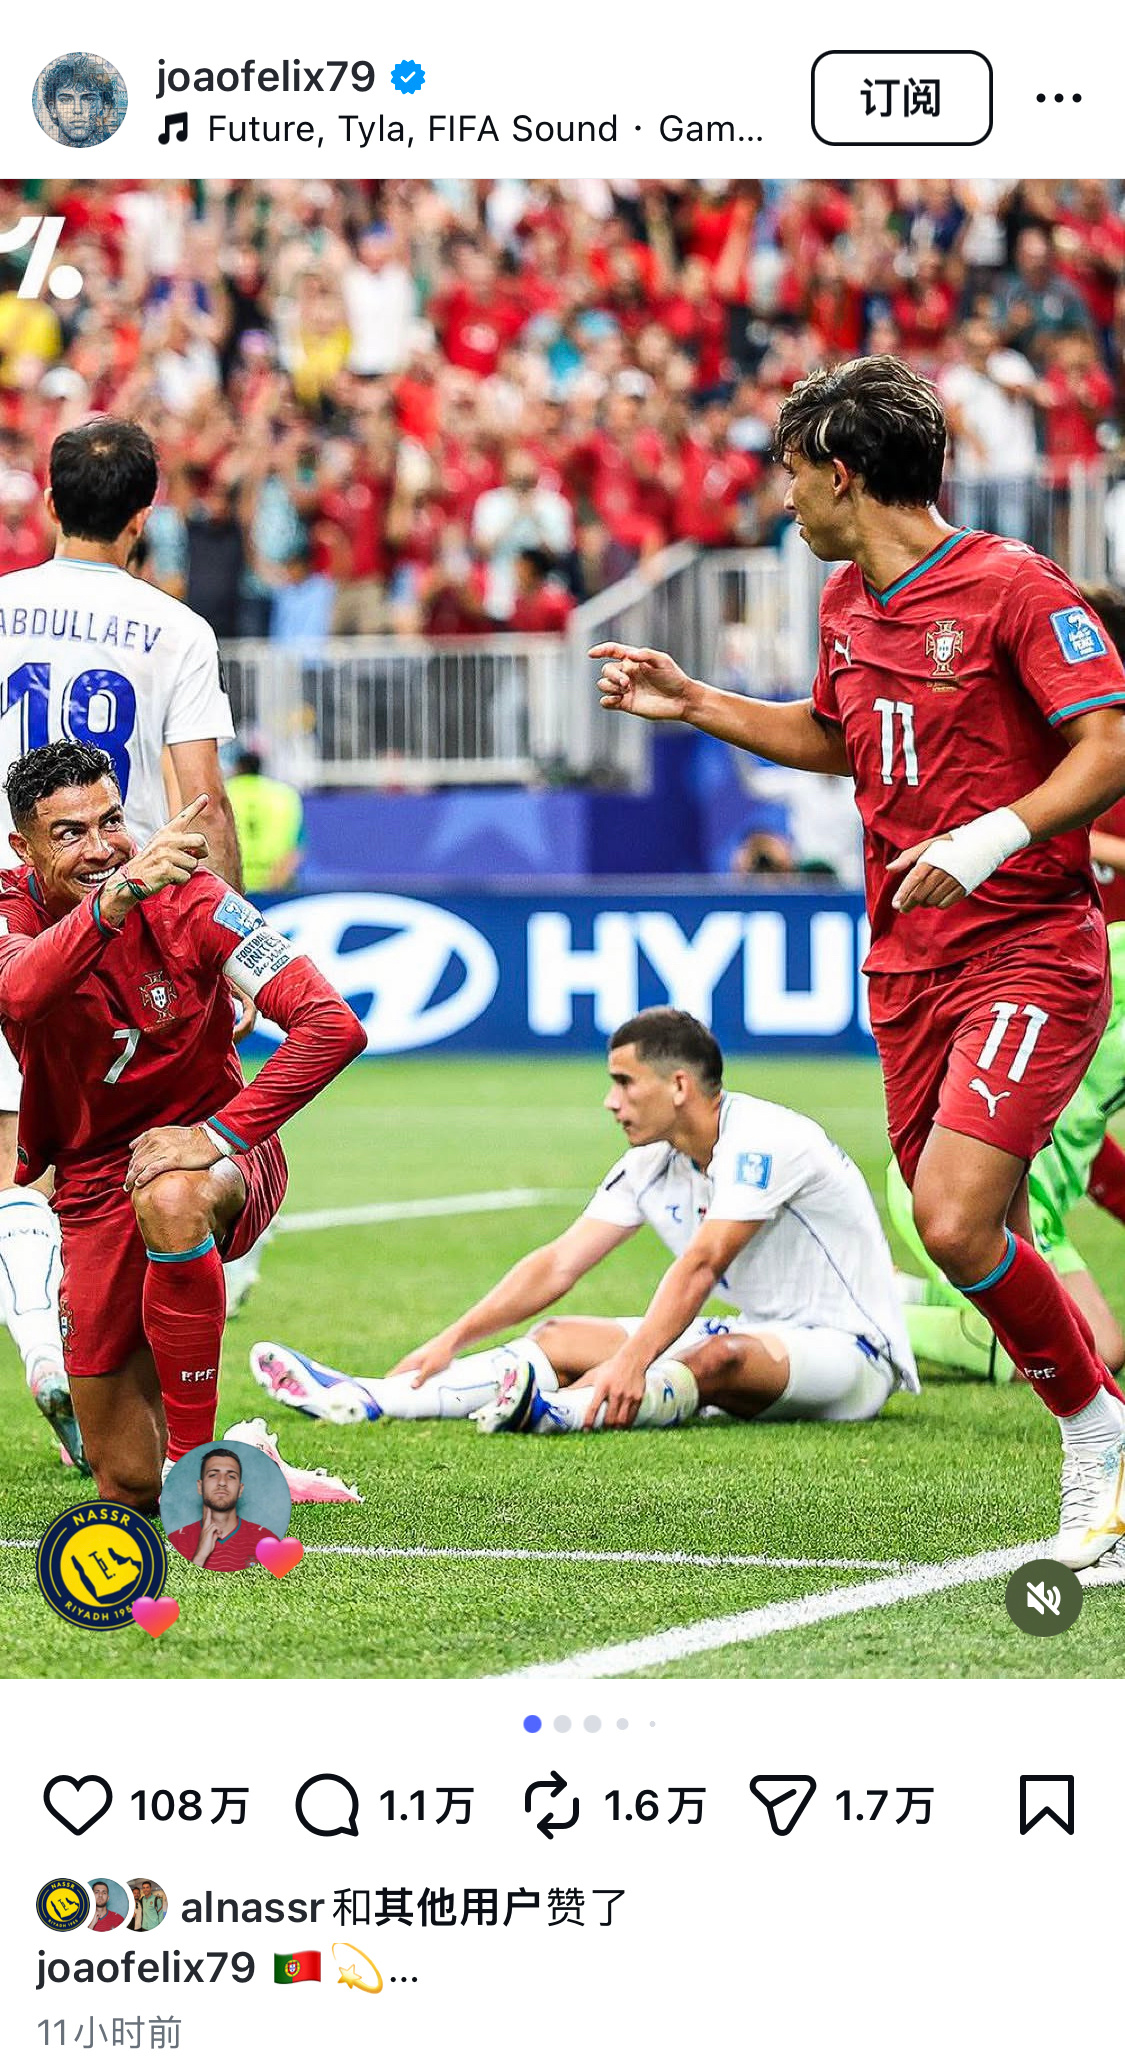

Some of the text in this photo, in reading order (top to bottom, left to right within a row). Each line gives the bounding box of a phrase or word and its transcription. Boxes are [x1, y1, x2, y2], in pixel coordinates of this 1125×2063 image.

[0, 662, 137, 806] 18
[873, 697, 919, 786] 11
[526, 910, 874, 1037] HYU
[103, 1028, 141, 1084] 7
[976, 1001, 1049, 1083] 11
